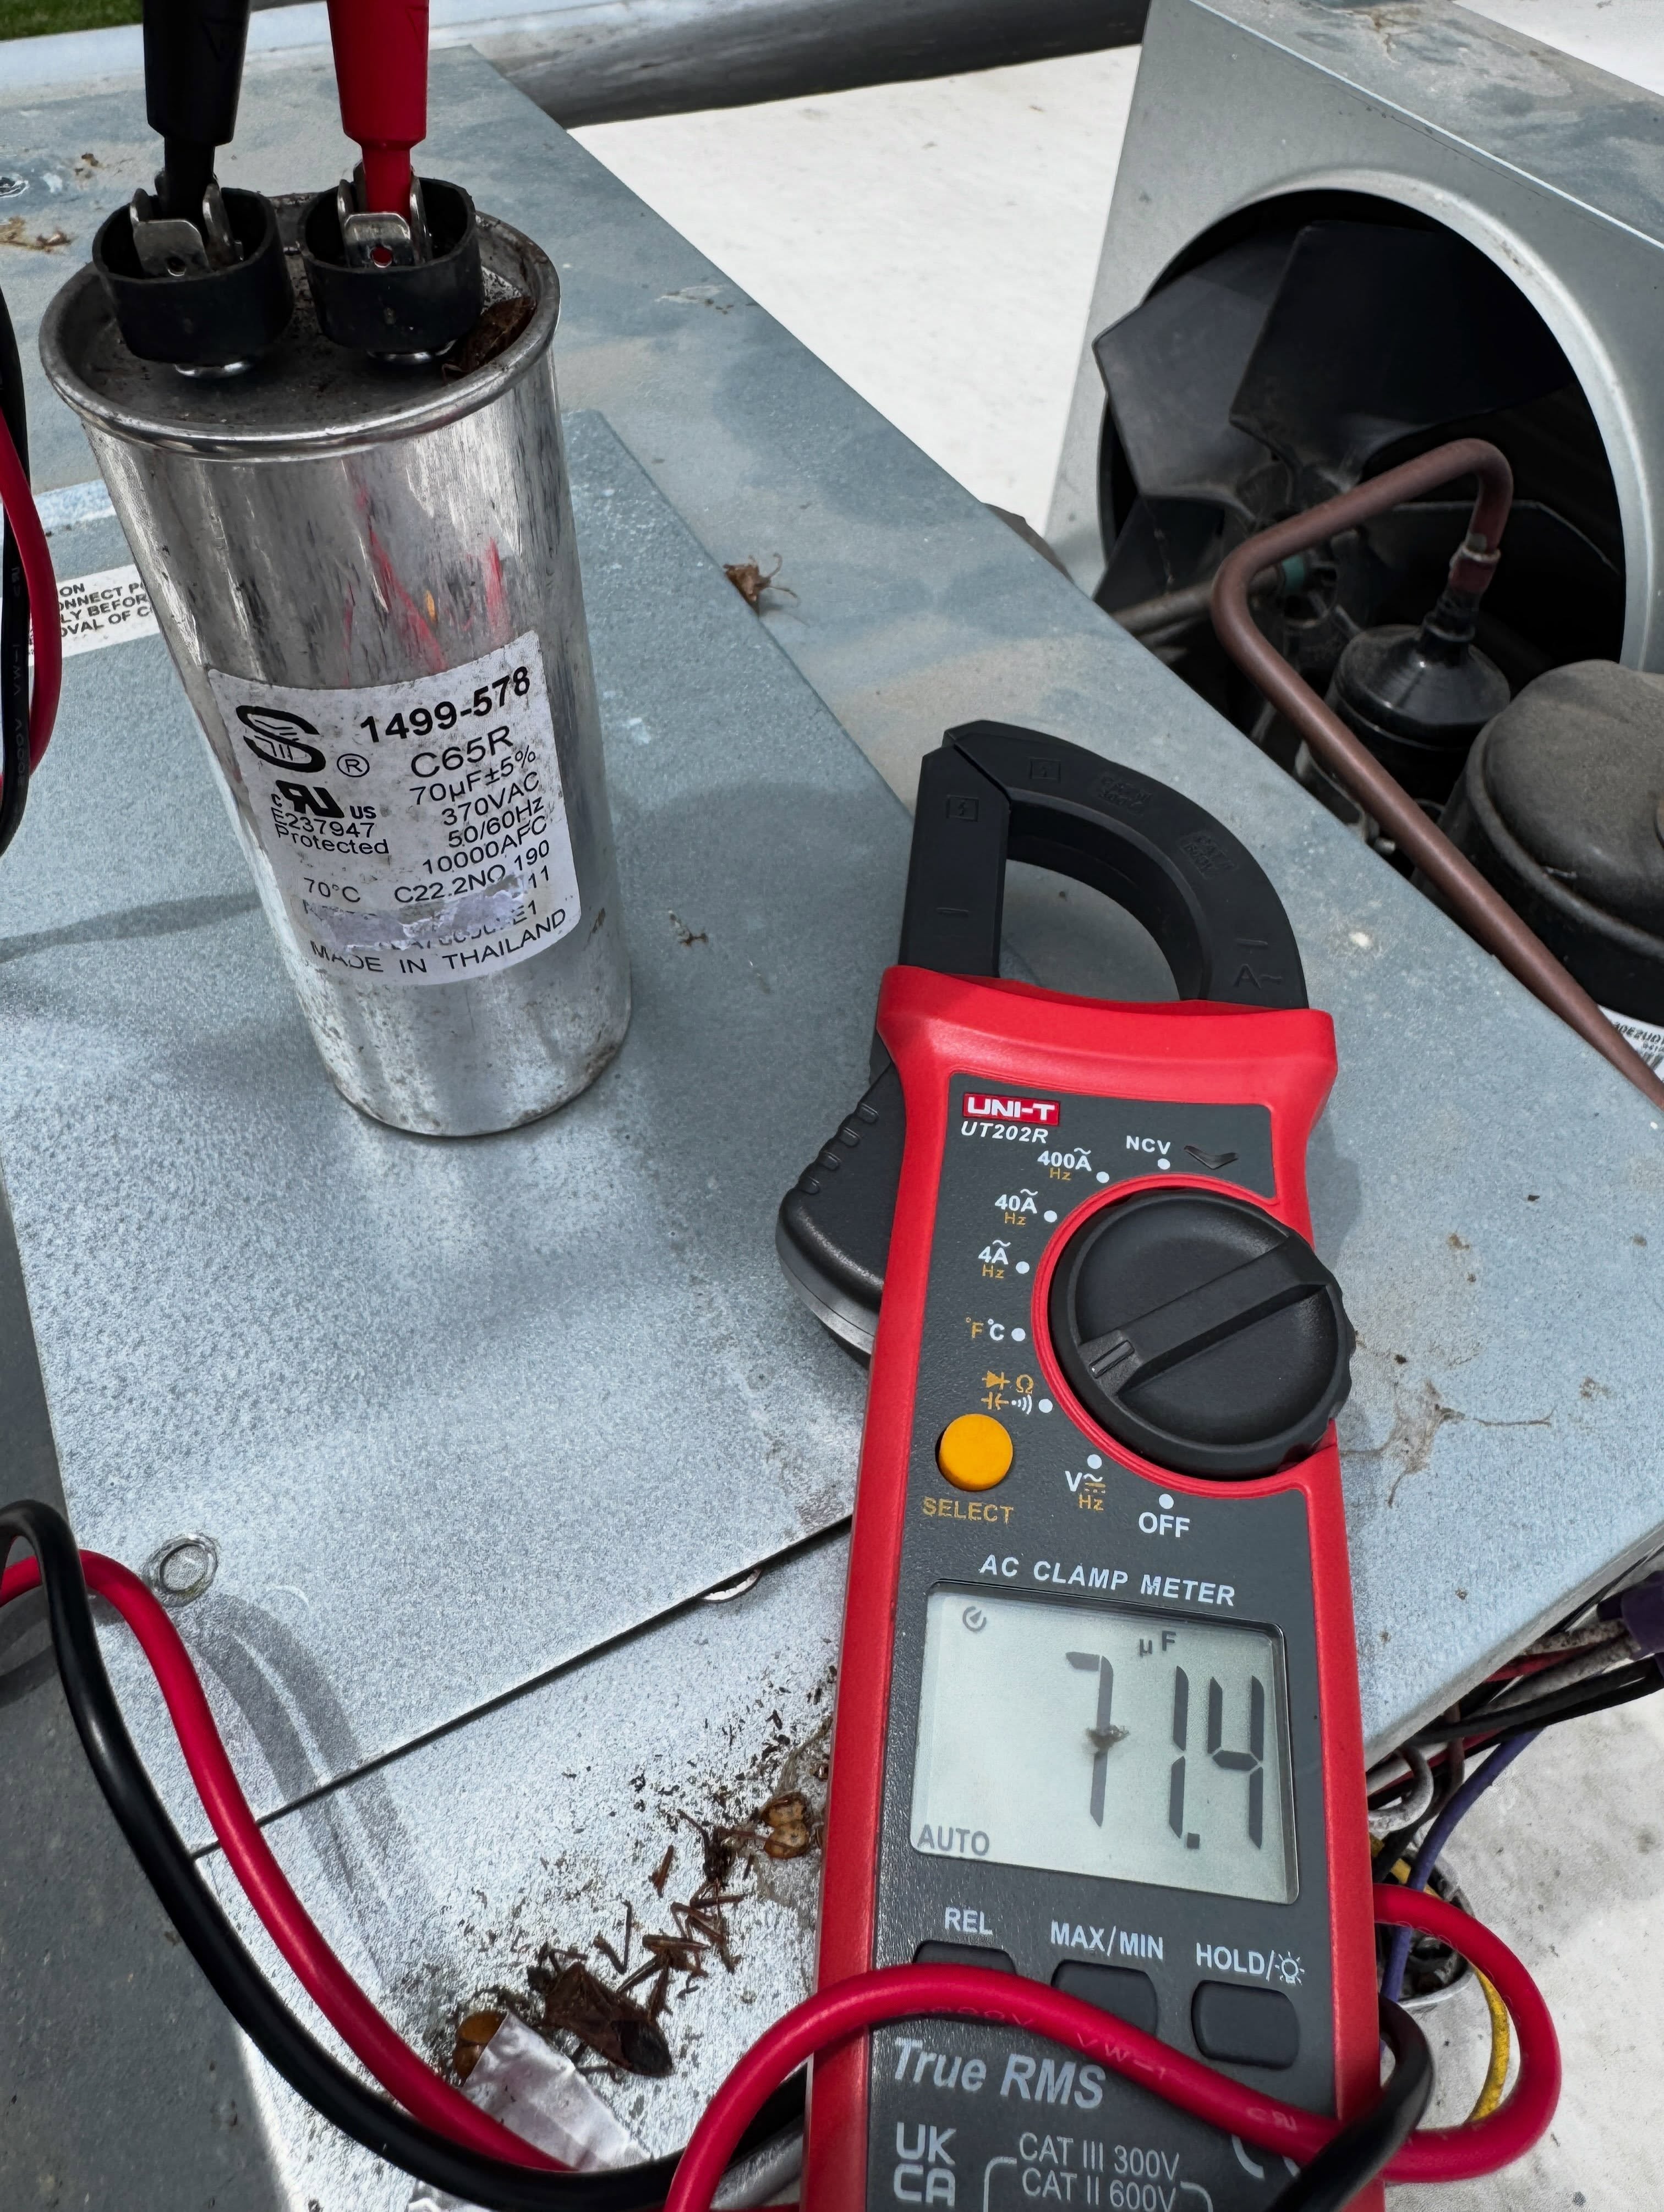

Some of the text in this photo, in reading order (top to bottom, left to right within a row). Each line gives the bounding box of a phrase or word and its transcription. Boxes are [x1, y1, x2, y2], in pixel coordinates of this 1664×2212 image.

[108, 611, 131, 624] OF
[360, 666, 530, 743] 1499-578
[411, 726, 513, 777] C65R
[442, 771, 539, 825] 370VAC
[271, 807, 375, 838] E237947
[448, 797, 544, 848] 50/60Hz
[275, 824, 389, 854] Protected
[423, 815, 546, 874] 10000AFC
[514, 839, 549, 871] 190
[304, 877, 360, 903] 70°C
[310, 940, 384, 972] MADE
[399, 959, 426, 973] IN
[442, 909, 566, 969] THAILAND
[967, 1097, 1055, 1120] UNI-T
[961, 1121, 1048, 1144] UT202R
[1125, 1135, 1170, 1155] NCV
[1049, 1167, 1072, 1181] Hz
[1005, 1212, 1026, 1225] Hz
[982, 1264, 1005, 1278] Hz
[922, 1496, 1014, 1524] SELECT
[1079, 1494, 1104, 1511] Hz
[1138, 1512, 1190, 1538] OFF
[979, 1554, 1235, 1606] AC CLAMP METER
[1066, 1652, 1264, 1850] 71.4
[917, 1825, 990, 1856] AUTO
[944, 1907, 992, 1935] REL
[1050, 1921, 1163, 1960] MAX/MIN
[894, 2037, 1106, 2109] True RMS
[896, 2122, 956, 2165] UK
[1020, 2132, 1179, 2180] CAT III 300V
[894, 2164, 955, 2207] CA
[1022, 2167, 1176, 2212] CAT II 600V
